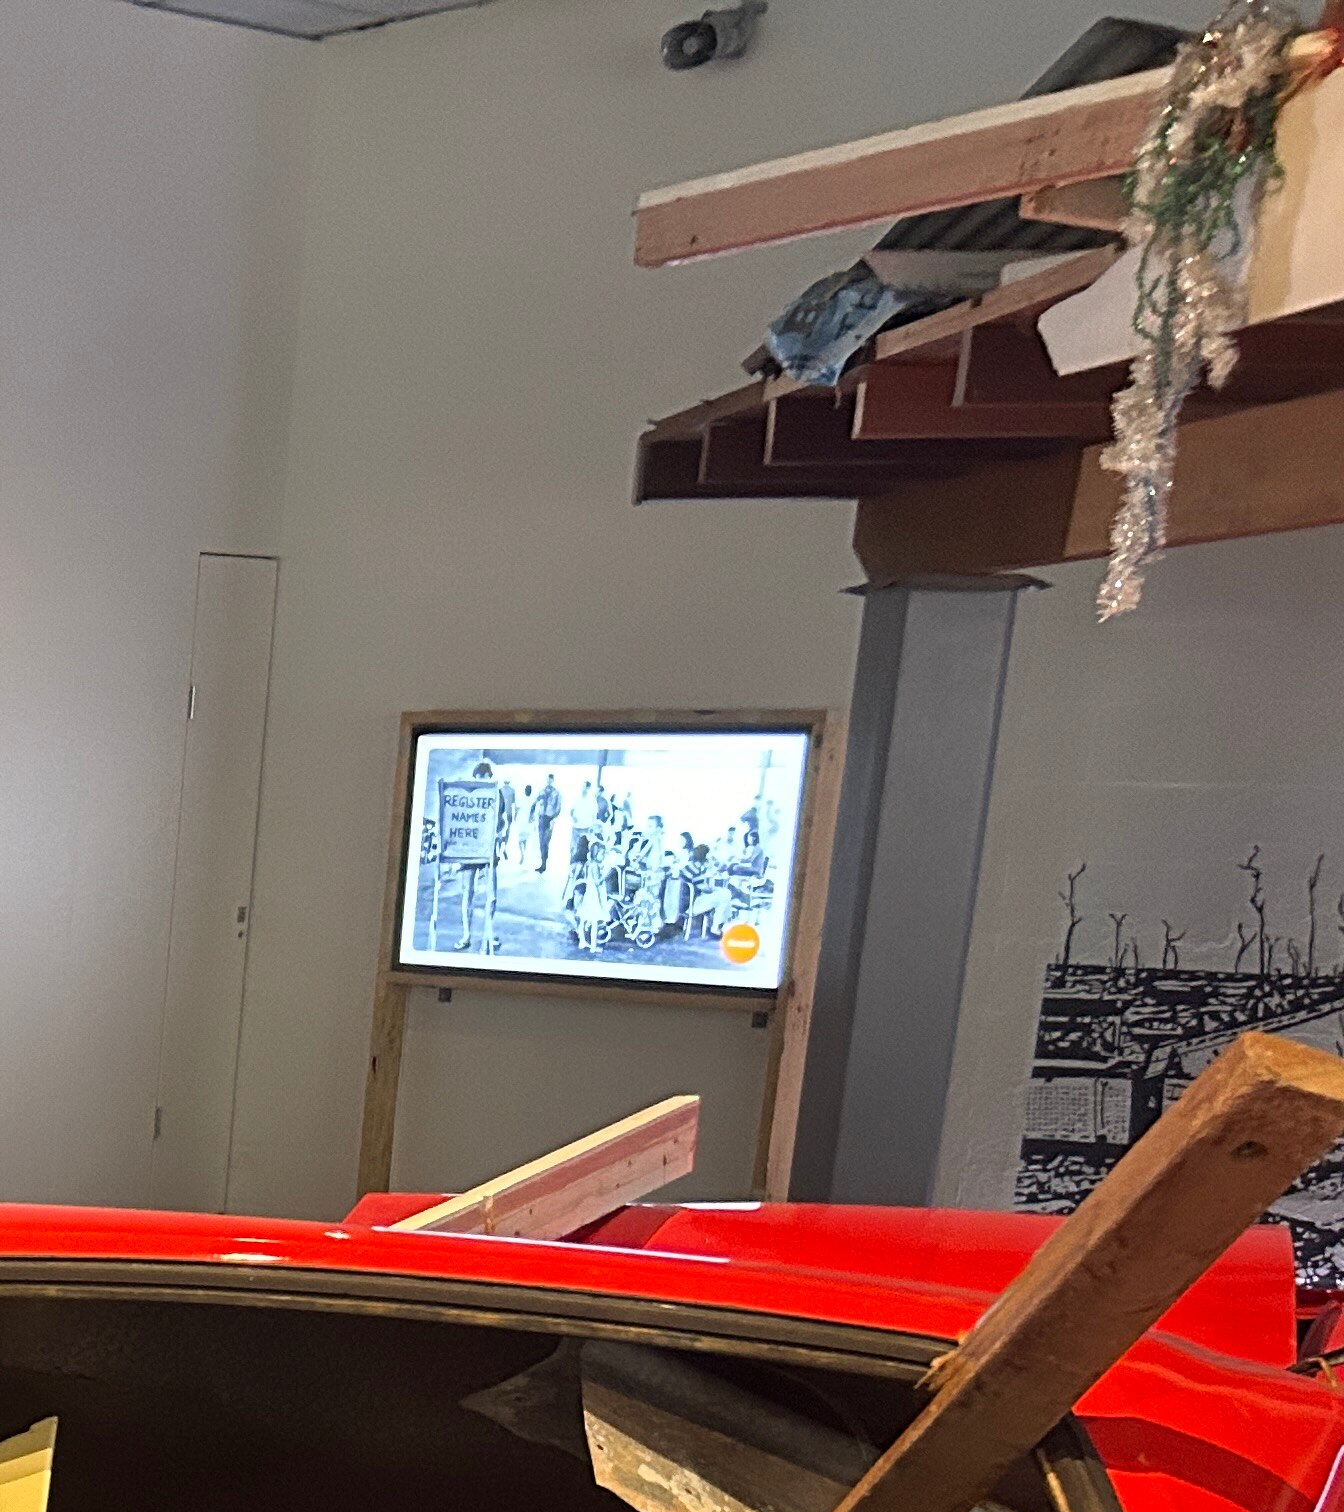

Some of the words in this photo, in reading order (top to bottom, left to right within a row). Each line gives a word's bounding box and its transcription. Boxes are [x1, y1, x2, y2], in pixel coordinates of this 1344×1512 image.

[443, 794, 495, 810] REGISTER
[451, 811, 487, 824] NAMES
[449, 827, 480, 840] HERE
